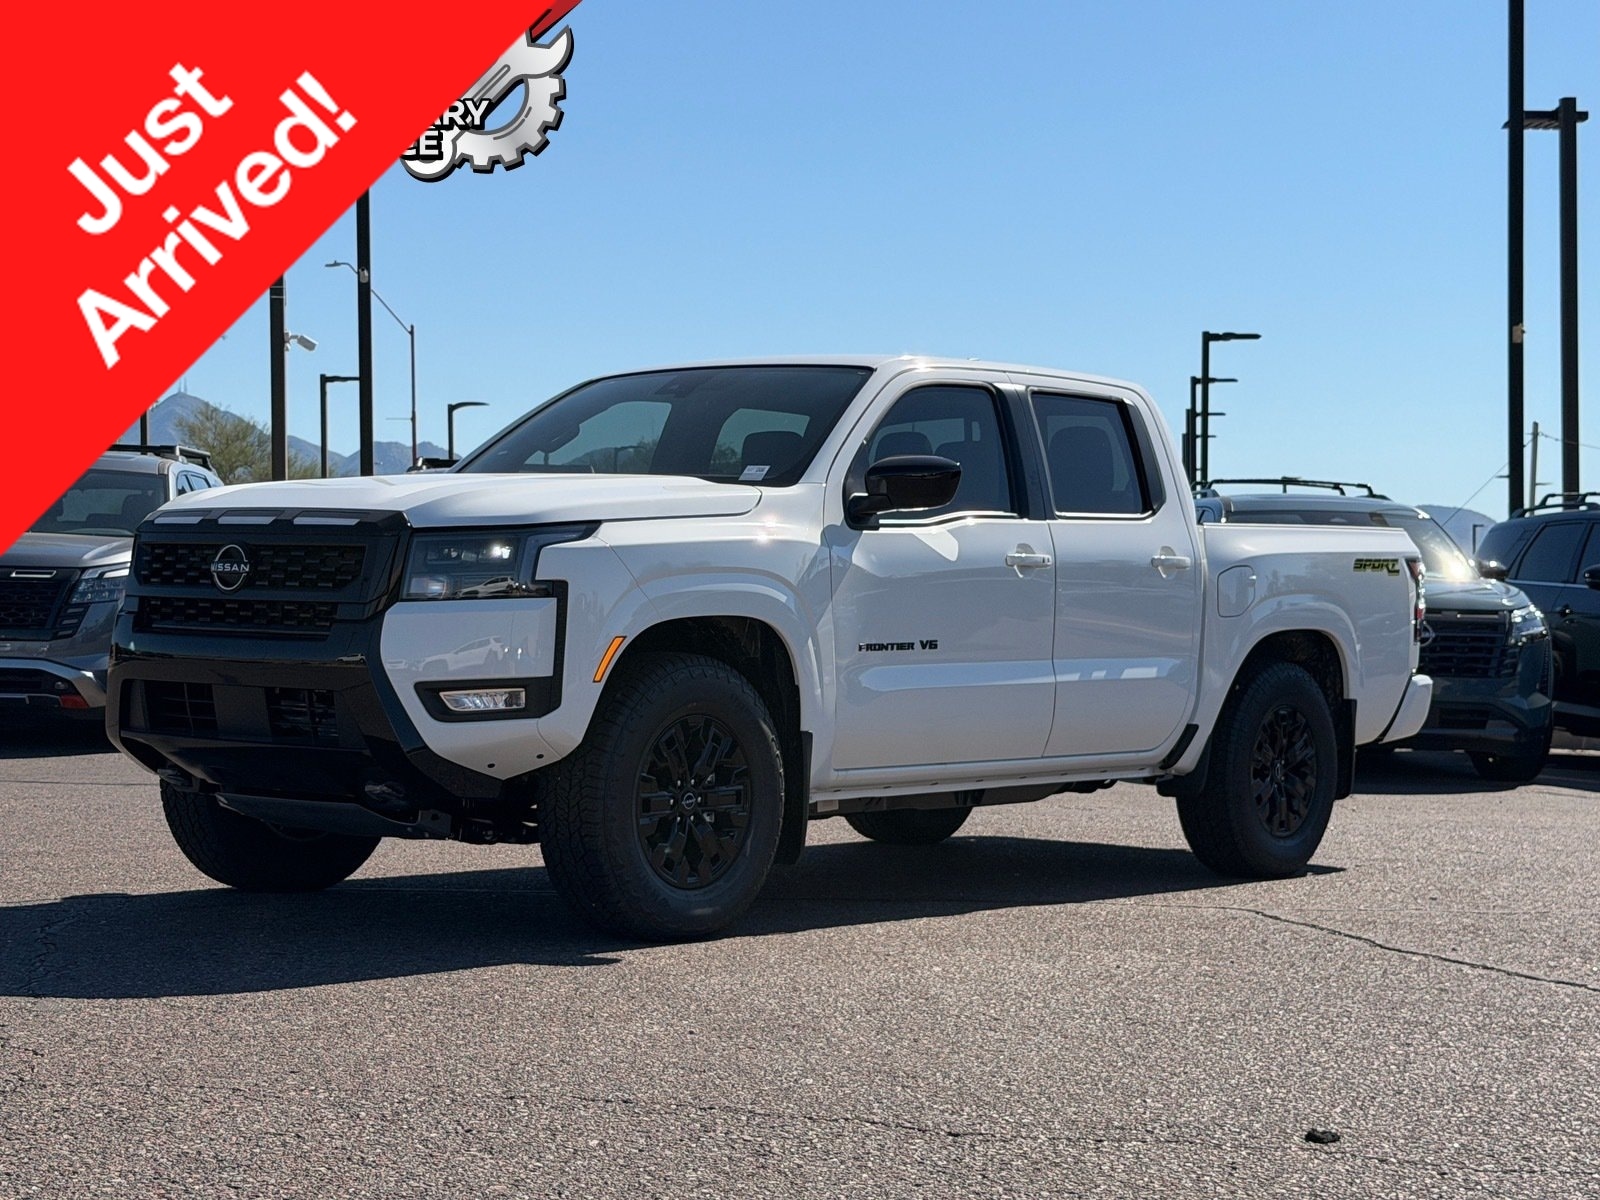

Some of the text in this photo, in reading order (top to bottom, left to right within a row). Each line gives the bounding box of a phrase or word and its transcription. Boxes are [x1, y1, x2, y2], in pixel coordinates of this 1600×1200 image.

[210, 562, 249, 572] NISSAN
[1353, 558, 1400, 576] SPORT
[858, 640, 938, 652] FRONTIER V6
